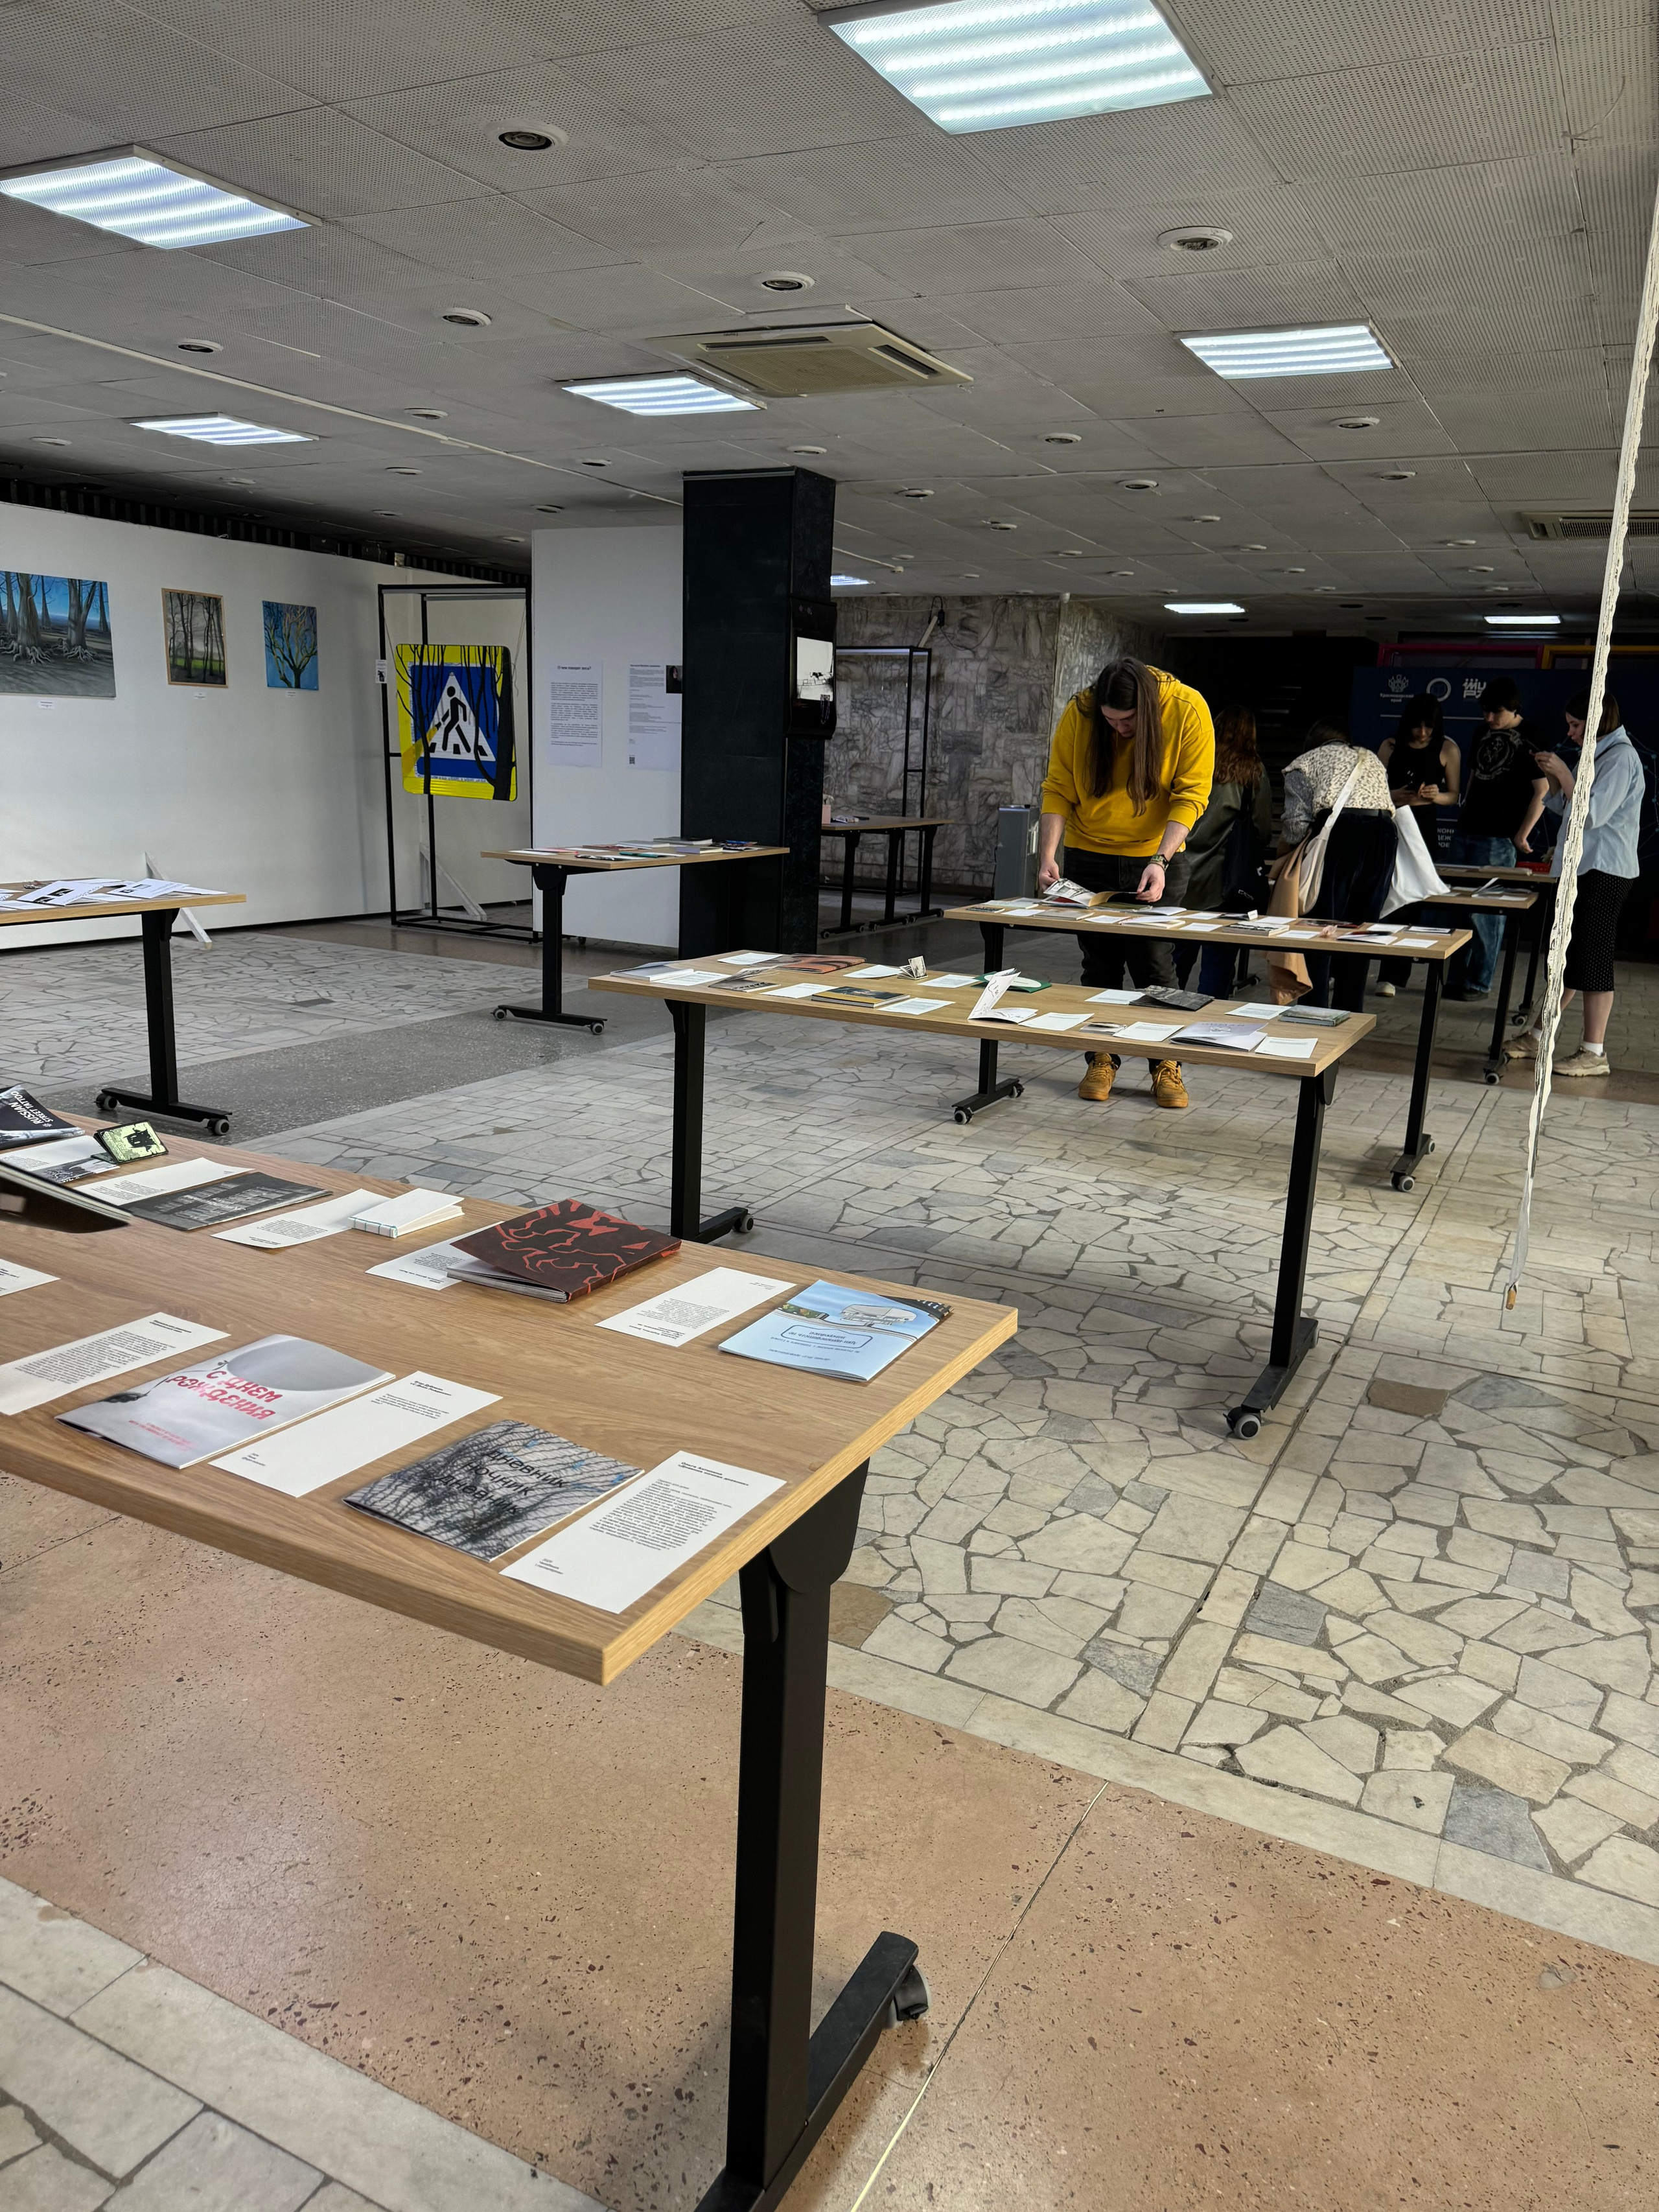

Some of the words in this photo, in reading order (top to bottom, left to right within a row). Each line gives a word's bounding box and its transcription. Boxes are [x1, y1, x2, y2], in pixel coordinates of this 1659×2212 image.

[10, 1091, 34, 1109] TATTOO
[8, 1102, 44, 1124] RUSSIAN
[30, 1108, 53, 1123] STREET
[165, 1376, 276, 1420] РОЖДЕНИЯ
[206, 1371, 227, 1379] С
[217, 1377, 283, 1403] ДНЕМ
